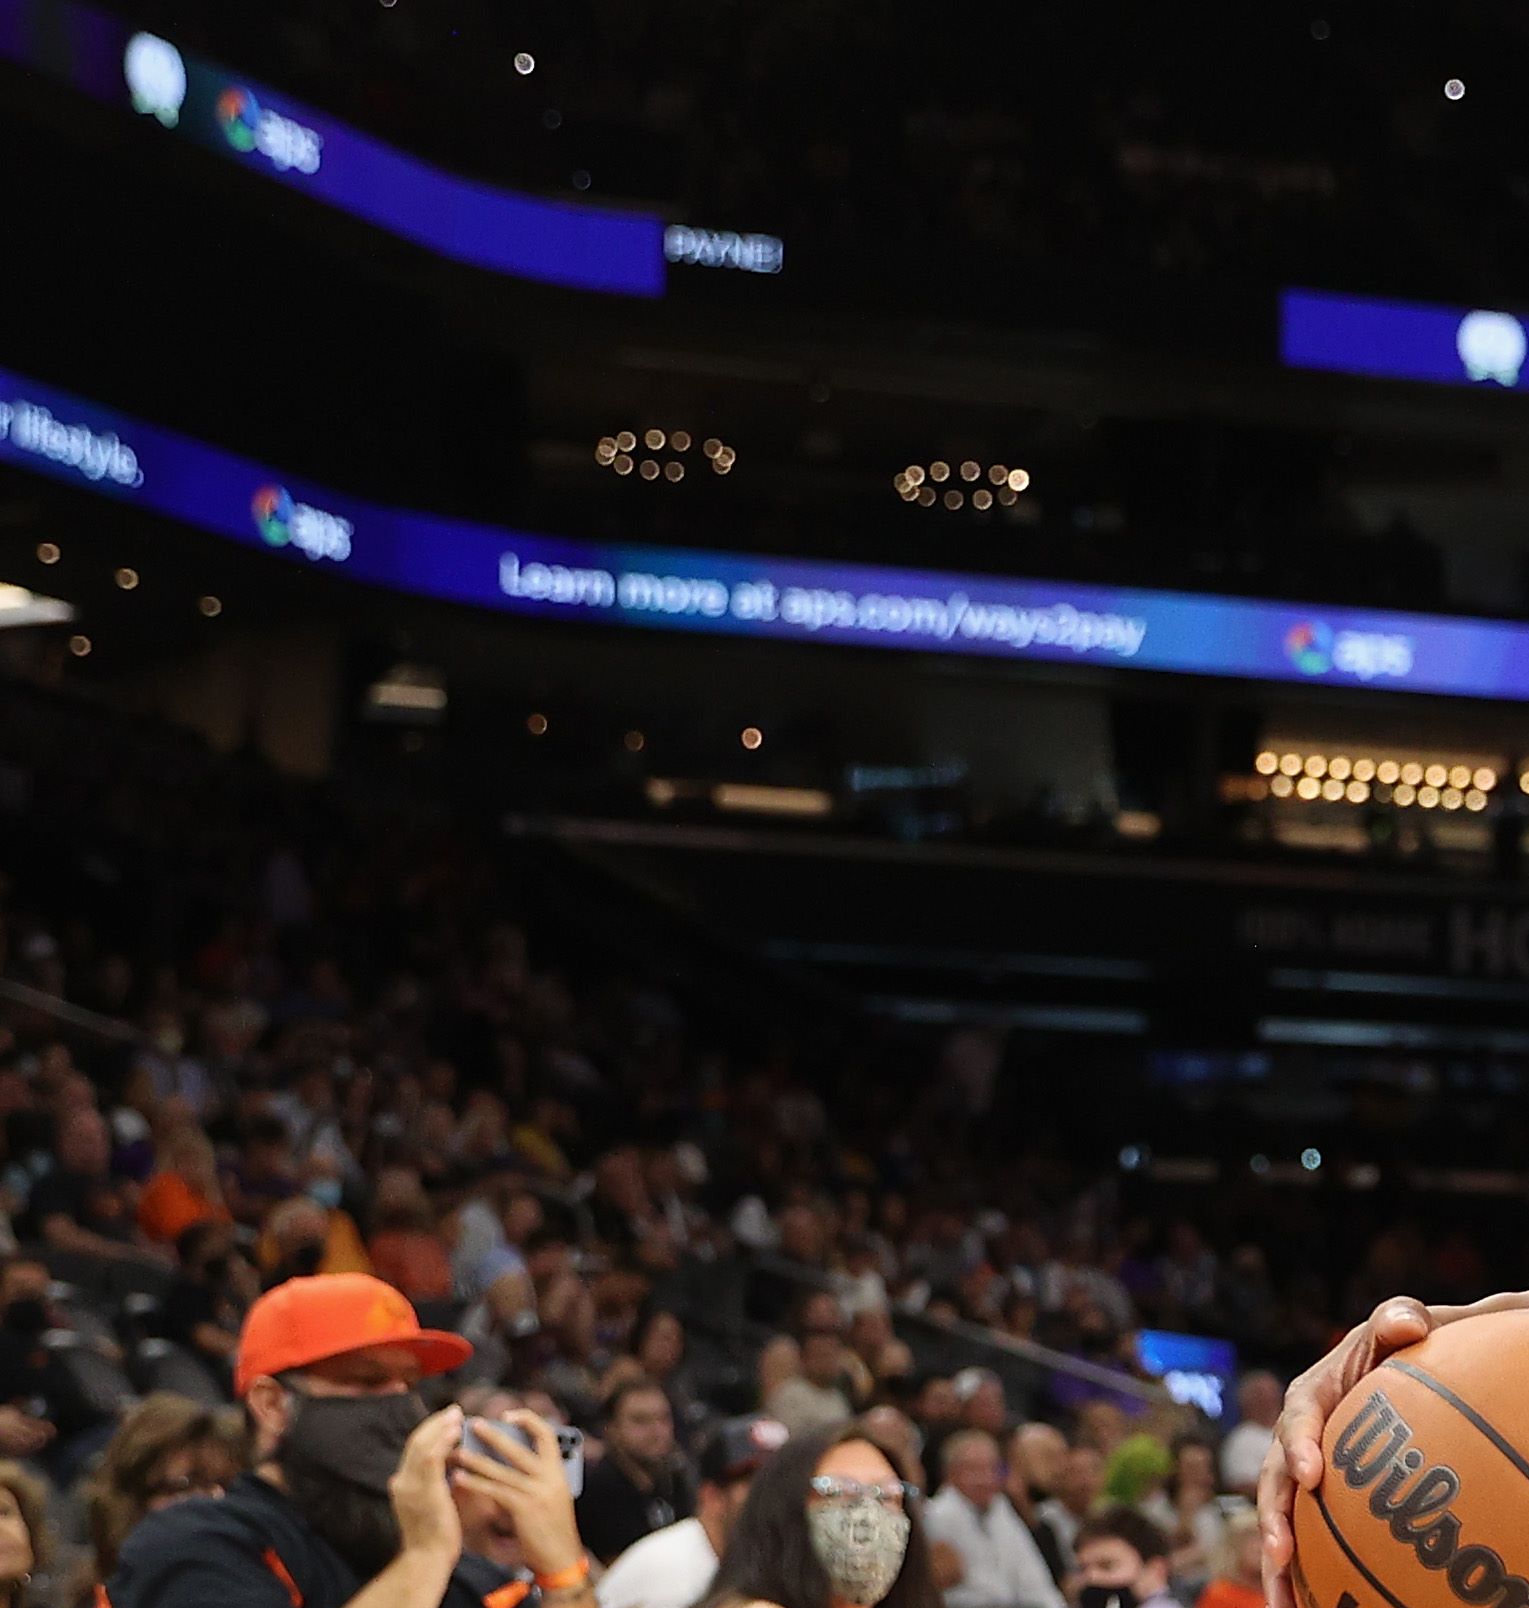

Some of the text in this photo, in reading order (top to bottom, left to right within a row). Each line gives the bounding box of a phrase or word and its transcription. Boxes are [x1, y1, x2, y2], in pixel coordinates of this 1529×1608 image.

[500, 552, 615, 605] Learn
[617, 572, 728, 618] more
[731, 578, 779, 621] at
[1332, 630, 1414, 682] aps
